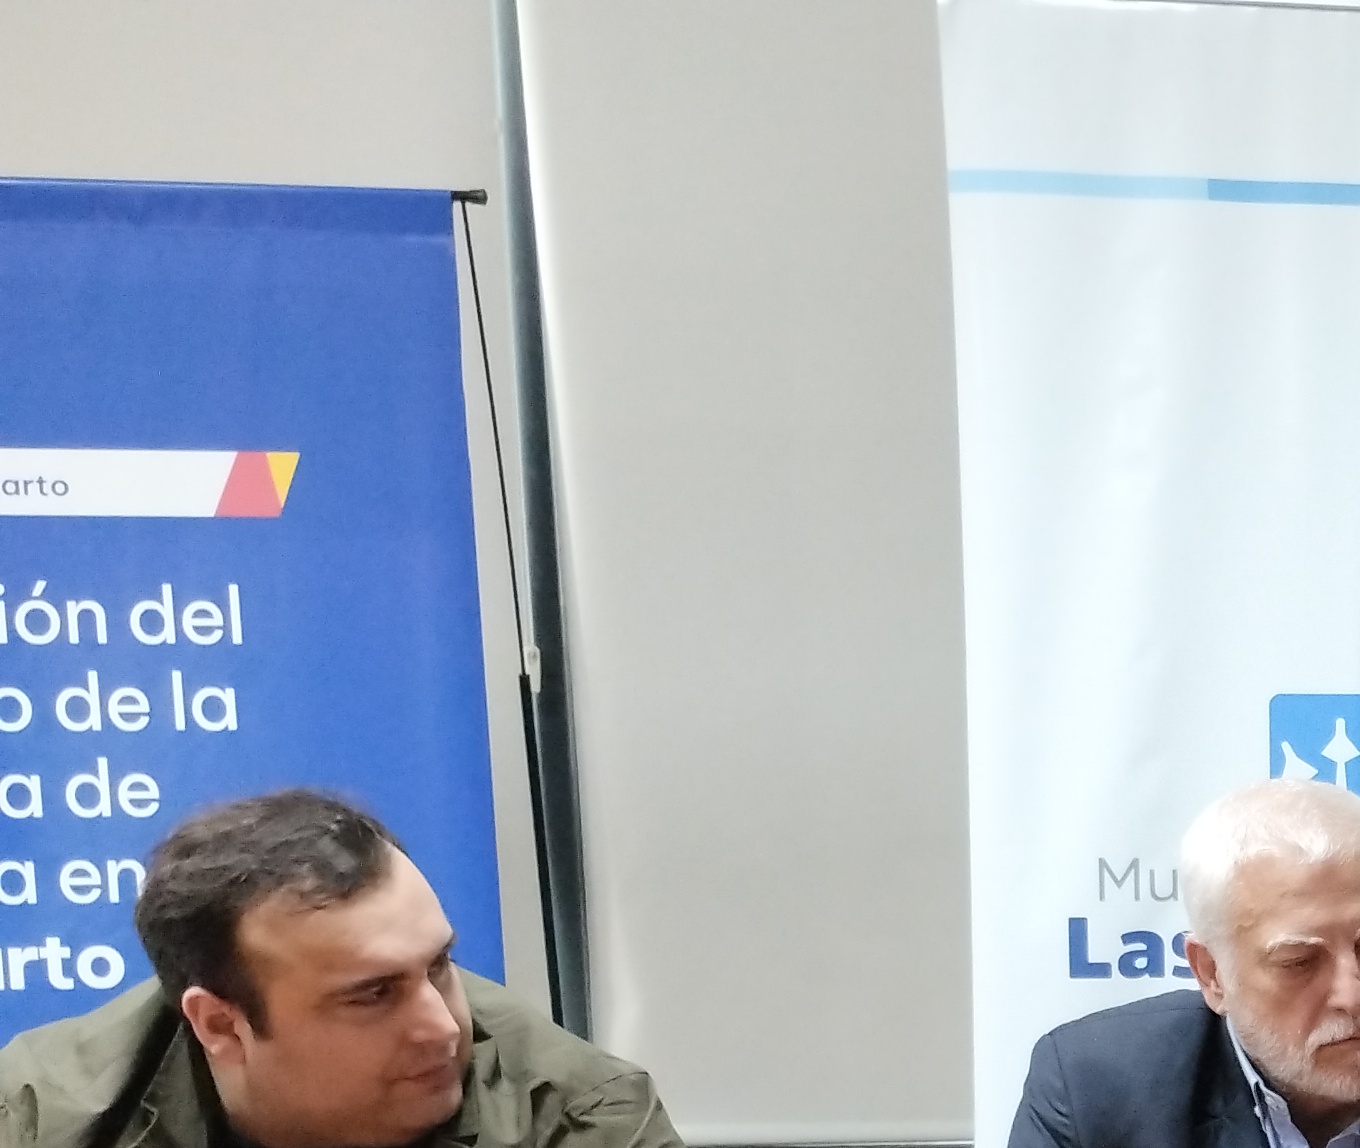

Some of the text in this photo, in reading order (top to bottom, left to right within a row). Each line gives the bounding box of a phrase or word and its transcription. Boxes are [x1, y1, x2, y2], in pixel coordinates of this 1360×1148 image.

[1, 475, 70, 497] arto
[129, 583, 243, 646] del
[55, 669, 151, 732] de
[171, 669, 238, 732] la
[0, 756, 160, 819] a de
[0, 858, 145, 906] a en
[0, 936, 125, 991] rto
